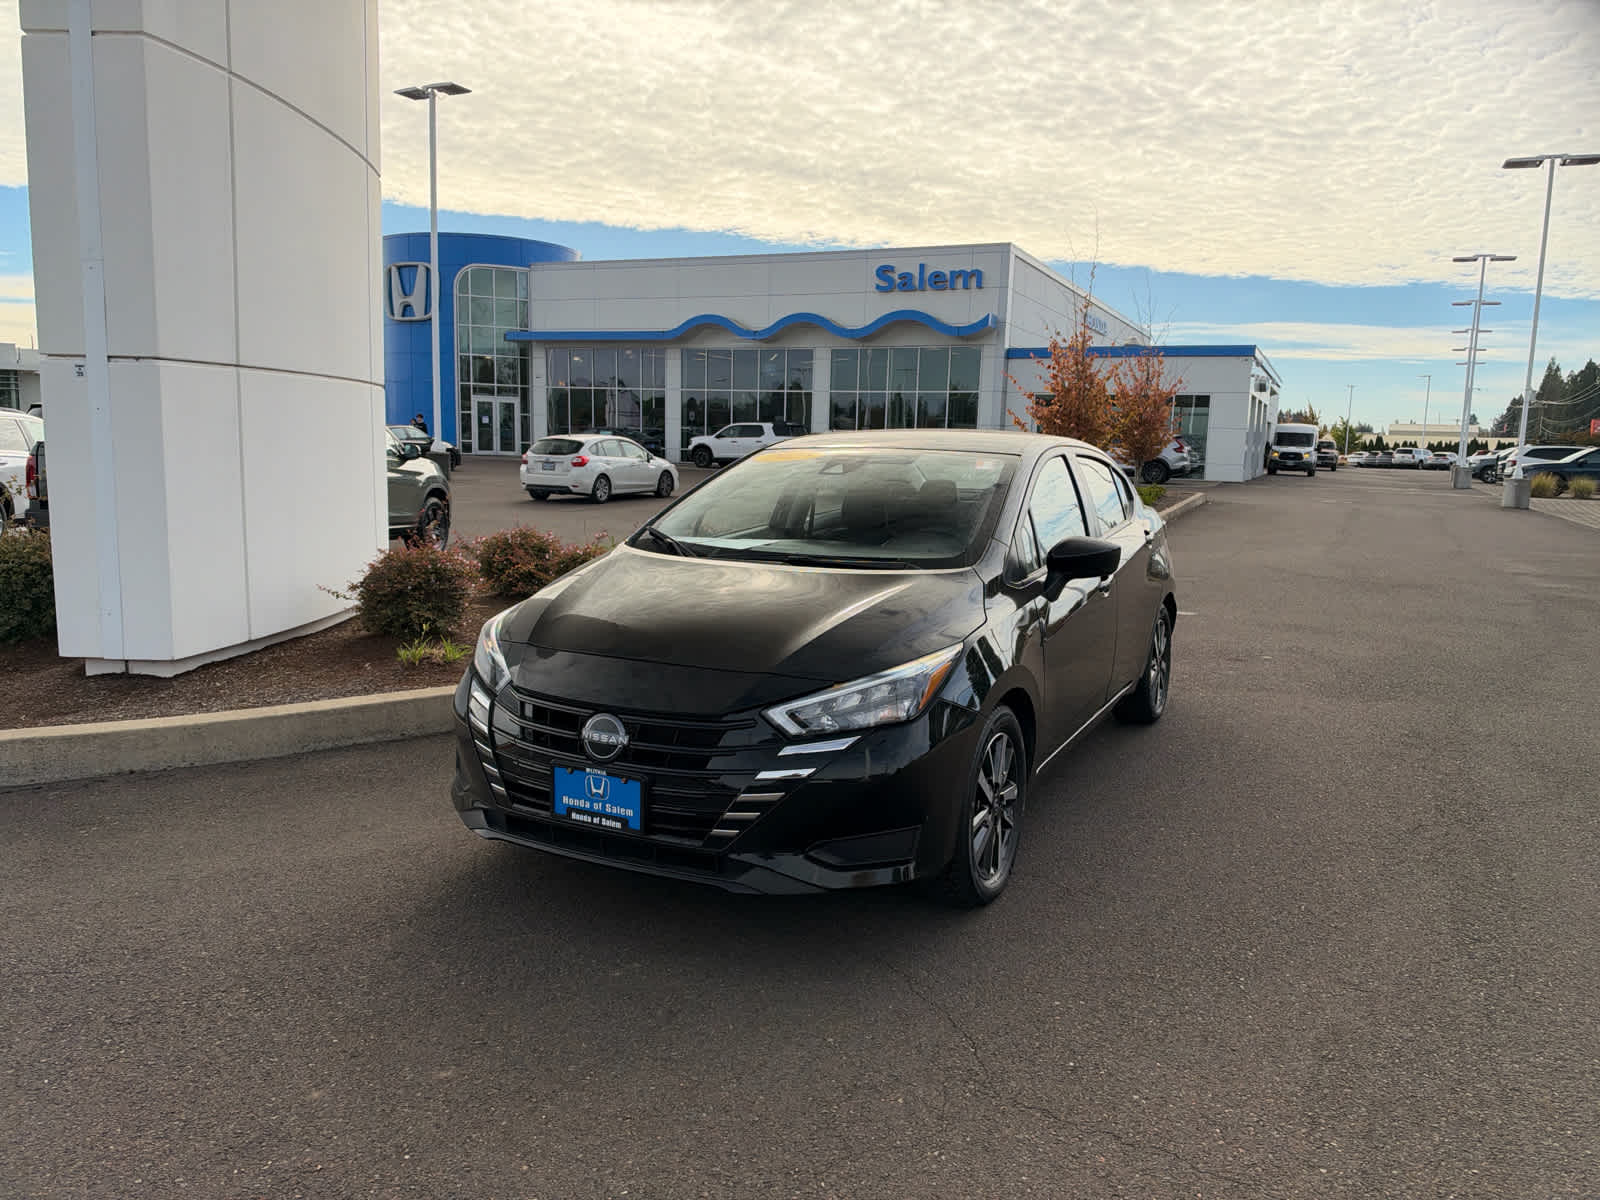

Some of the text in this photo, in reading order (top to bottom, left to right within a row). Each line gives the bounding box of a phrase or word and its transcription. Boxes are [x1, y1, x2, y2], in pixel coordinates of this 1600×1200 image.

[875, 263, 984, 292] Salem
[581, 728, 629, 746] NISSAN
[562, 795, 634, 817] Honda of Salem
[571, 812, 622, 829] Honda of Salem
